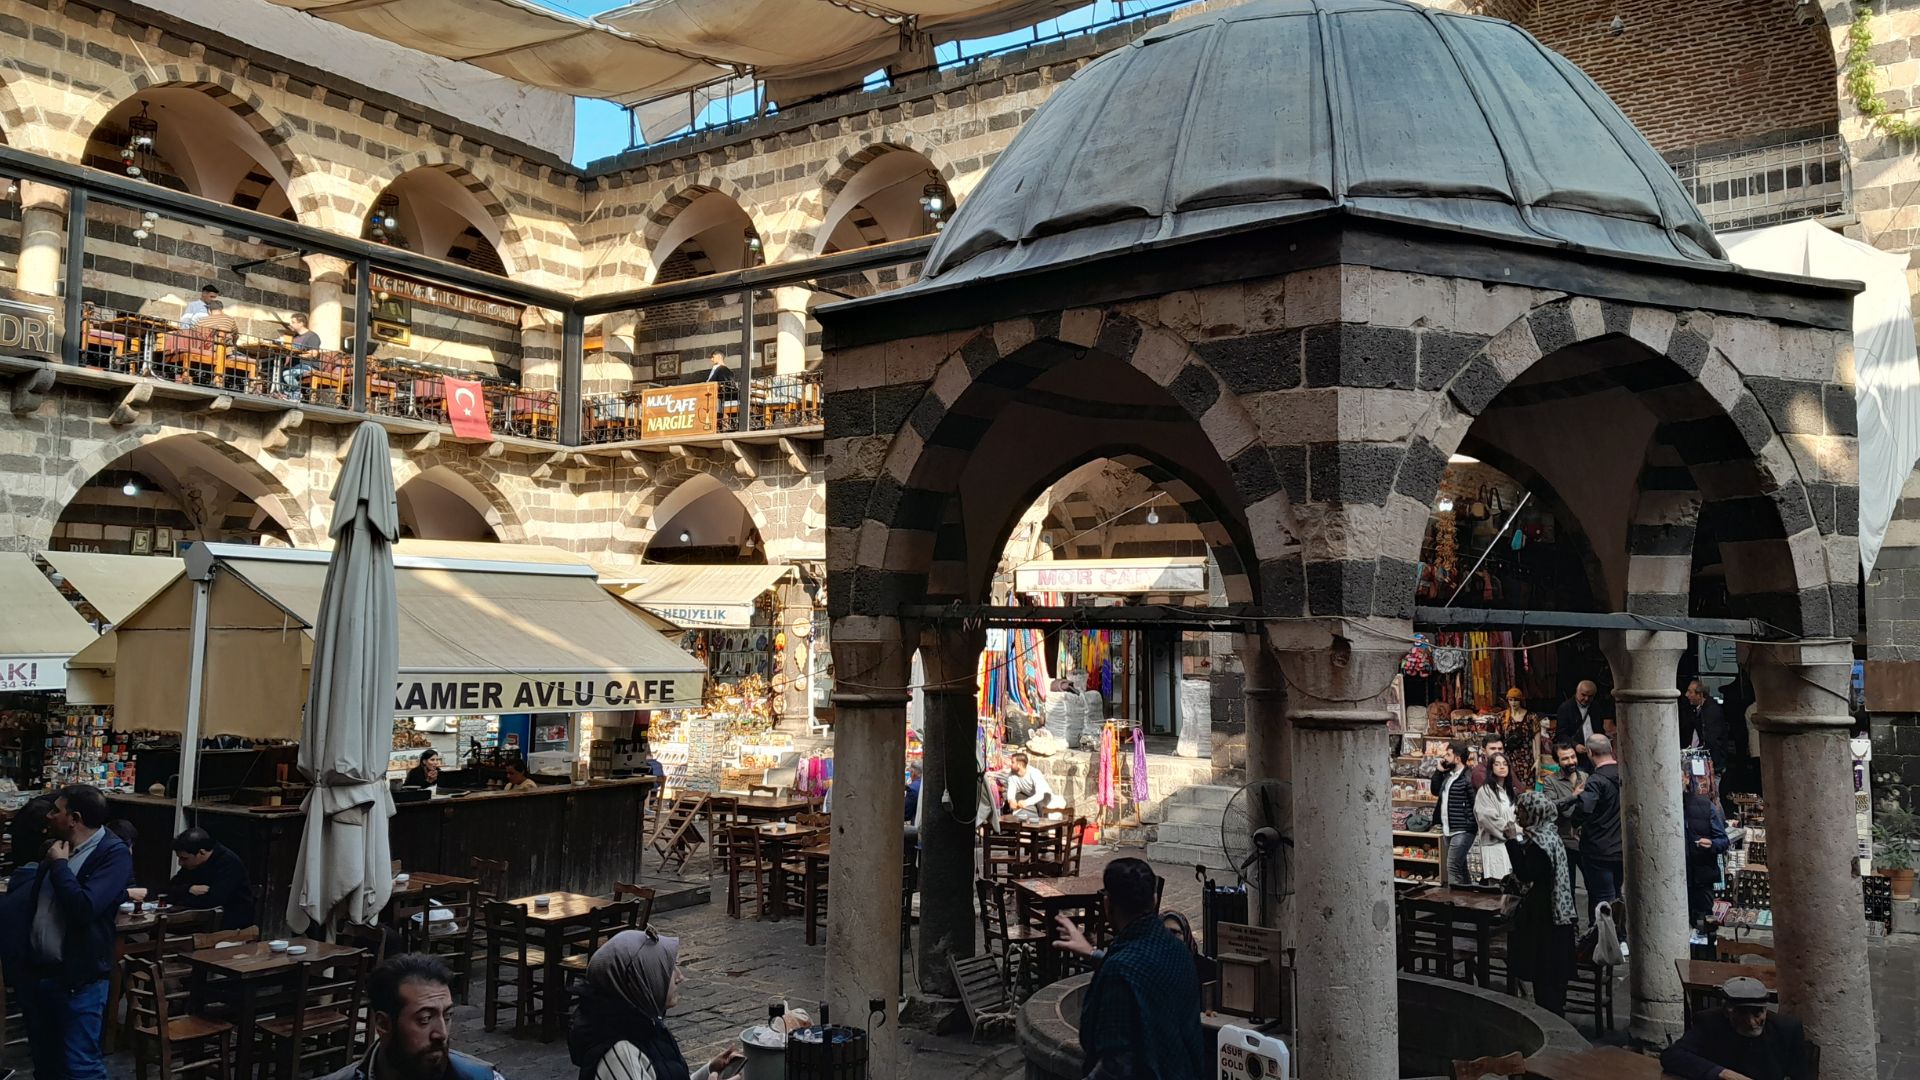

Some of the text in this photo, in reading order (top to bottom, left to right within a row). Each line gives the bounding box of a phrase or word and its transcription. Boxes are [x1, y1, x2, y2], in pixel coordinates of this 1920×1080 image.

[667, 398, 697, 413] CAFE
[647, 413, 696, 432] NARGİLE
[1038, 569, 1092, 585] MOR
[663, 606, 726, 620] HEDİYELİK
[0, 663, 37, 680] KI
[513, 680, 594, 708] AVLU
[604, 679, 675, 706] CAFE
[1222, 1058, 1244, 1071] GOLD
